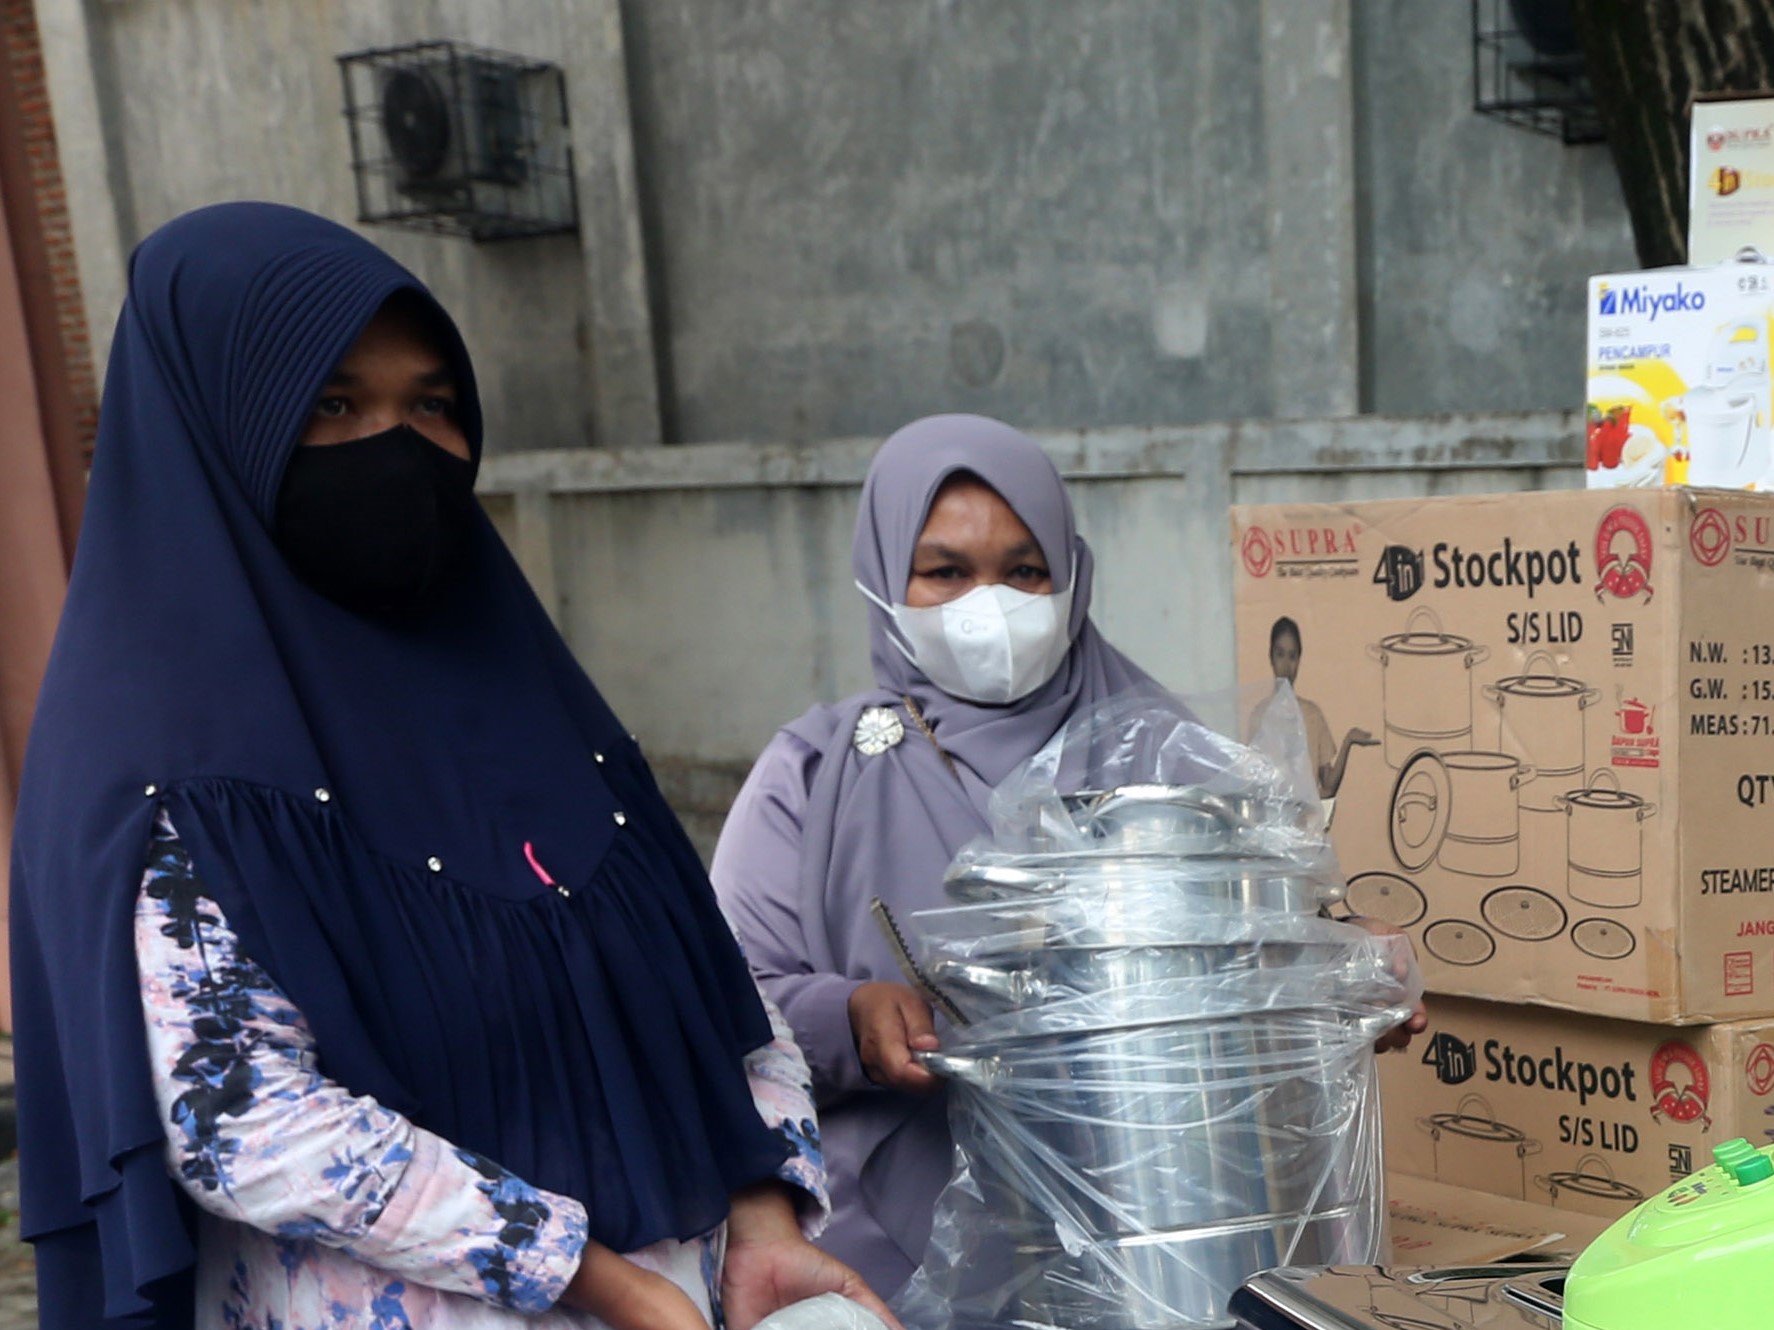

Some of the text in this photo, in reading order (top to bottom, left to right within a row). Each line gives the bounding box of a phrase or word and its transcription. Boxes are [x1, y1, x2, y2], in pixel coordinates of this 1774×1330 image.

[1620, 282, 1705, 321] Miyako
[1598, 343, 1672, 361] PENCAMPUR
[1274, 527, 1357, 555] SUPRA
[1433, 537, 1582, 599] Stockpot
[1507, 611, 1583, 645] S/S LID
[1611, 624, 1634, 655] SNI
[1690, 642, 1728, 664] N.W.
[1690, 678, 1728, 700] G.W.
[1690, 714, 1738, 736] MEAS
[1484, 1038, 1636, 1106] Stockpot
[1559, 1115, 1639, 1153] S/S LID
[1668, 1145, 1692, 1173] SNI
